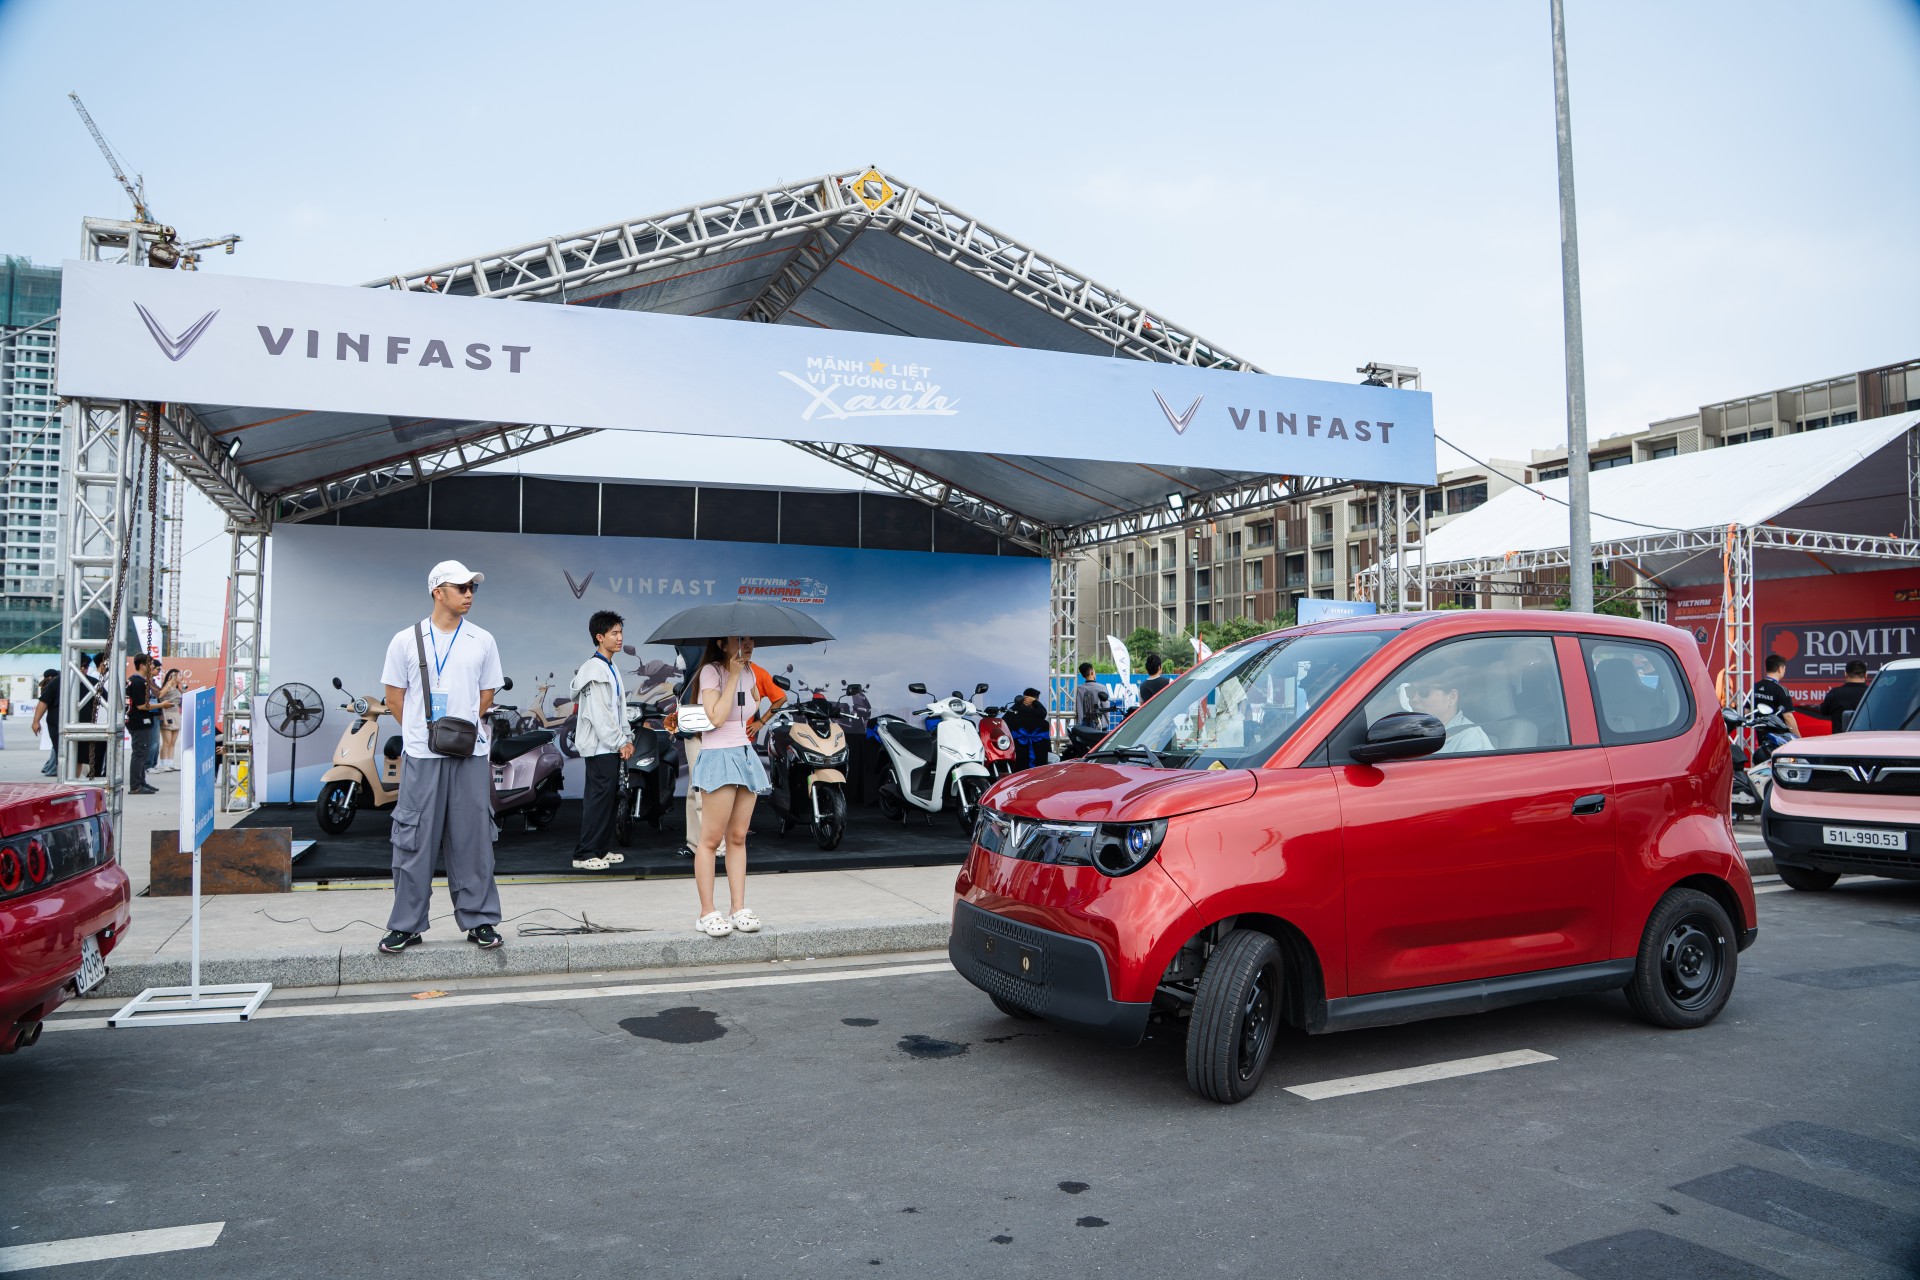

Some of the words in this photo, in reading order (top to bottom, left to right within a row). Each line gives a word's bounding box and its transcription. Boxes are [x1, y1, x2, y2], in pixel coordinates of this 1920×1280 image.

[257, 325, 532, 374] VINFAST
[806, 355, 864, 373] MÃNH
[891, 362, 932, 381] LIỆT
[806, 370, 826, 385] VÌ
[830, 373, 898, 391] TƯƠNG
[777, 370, 961, 421] Xanh
[1227, 406, 1395, 444] VINFAST
[608, 577, 717, 596] VINFAST
[737, 586, 802, 597] GYMKHANA
[740, 577, 788, 587] VIETNAM
[1330, 607, 1354, 615] VINFAST
[1677, 598, 1711, 607] VIETNAM
[1803, 627, 1916, 657] ROMIT
